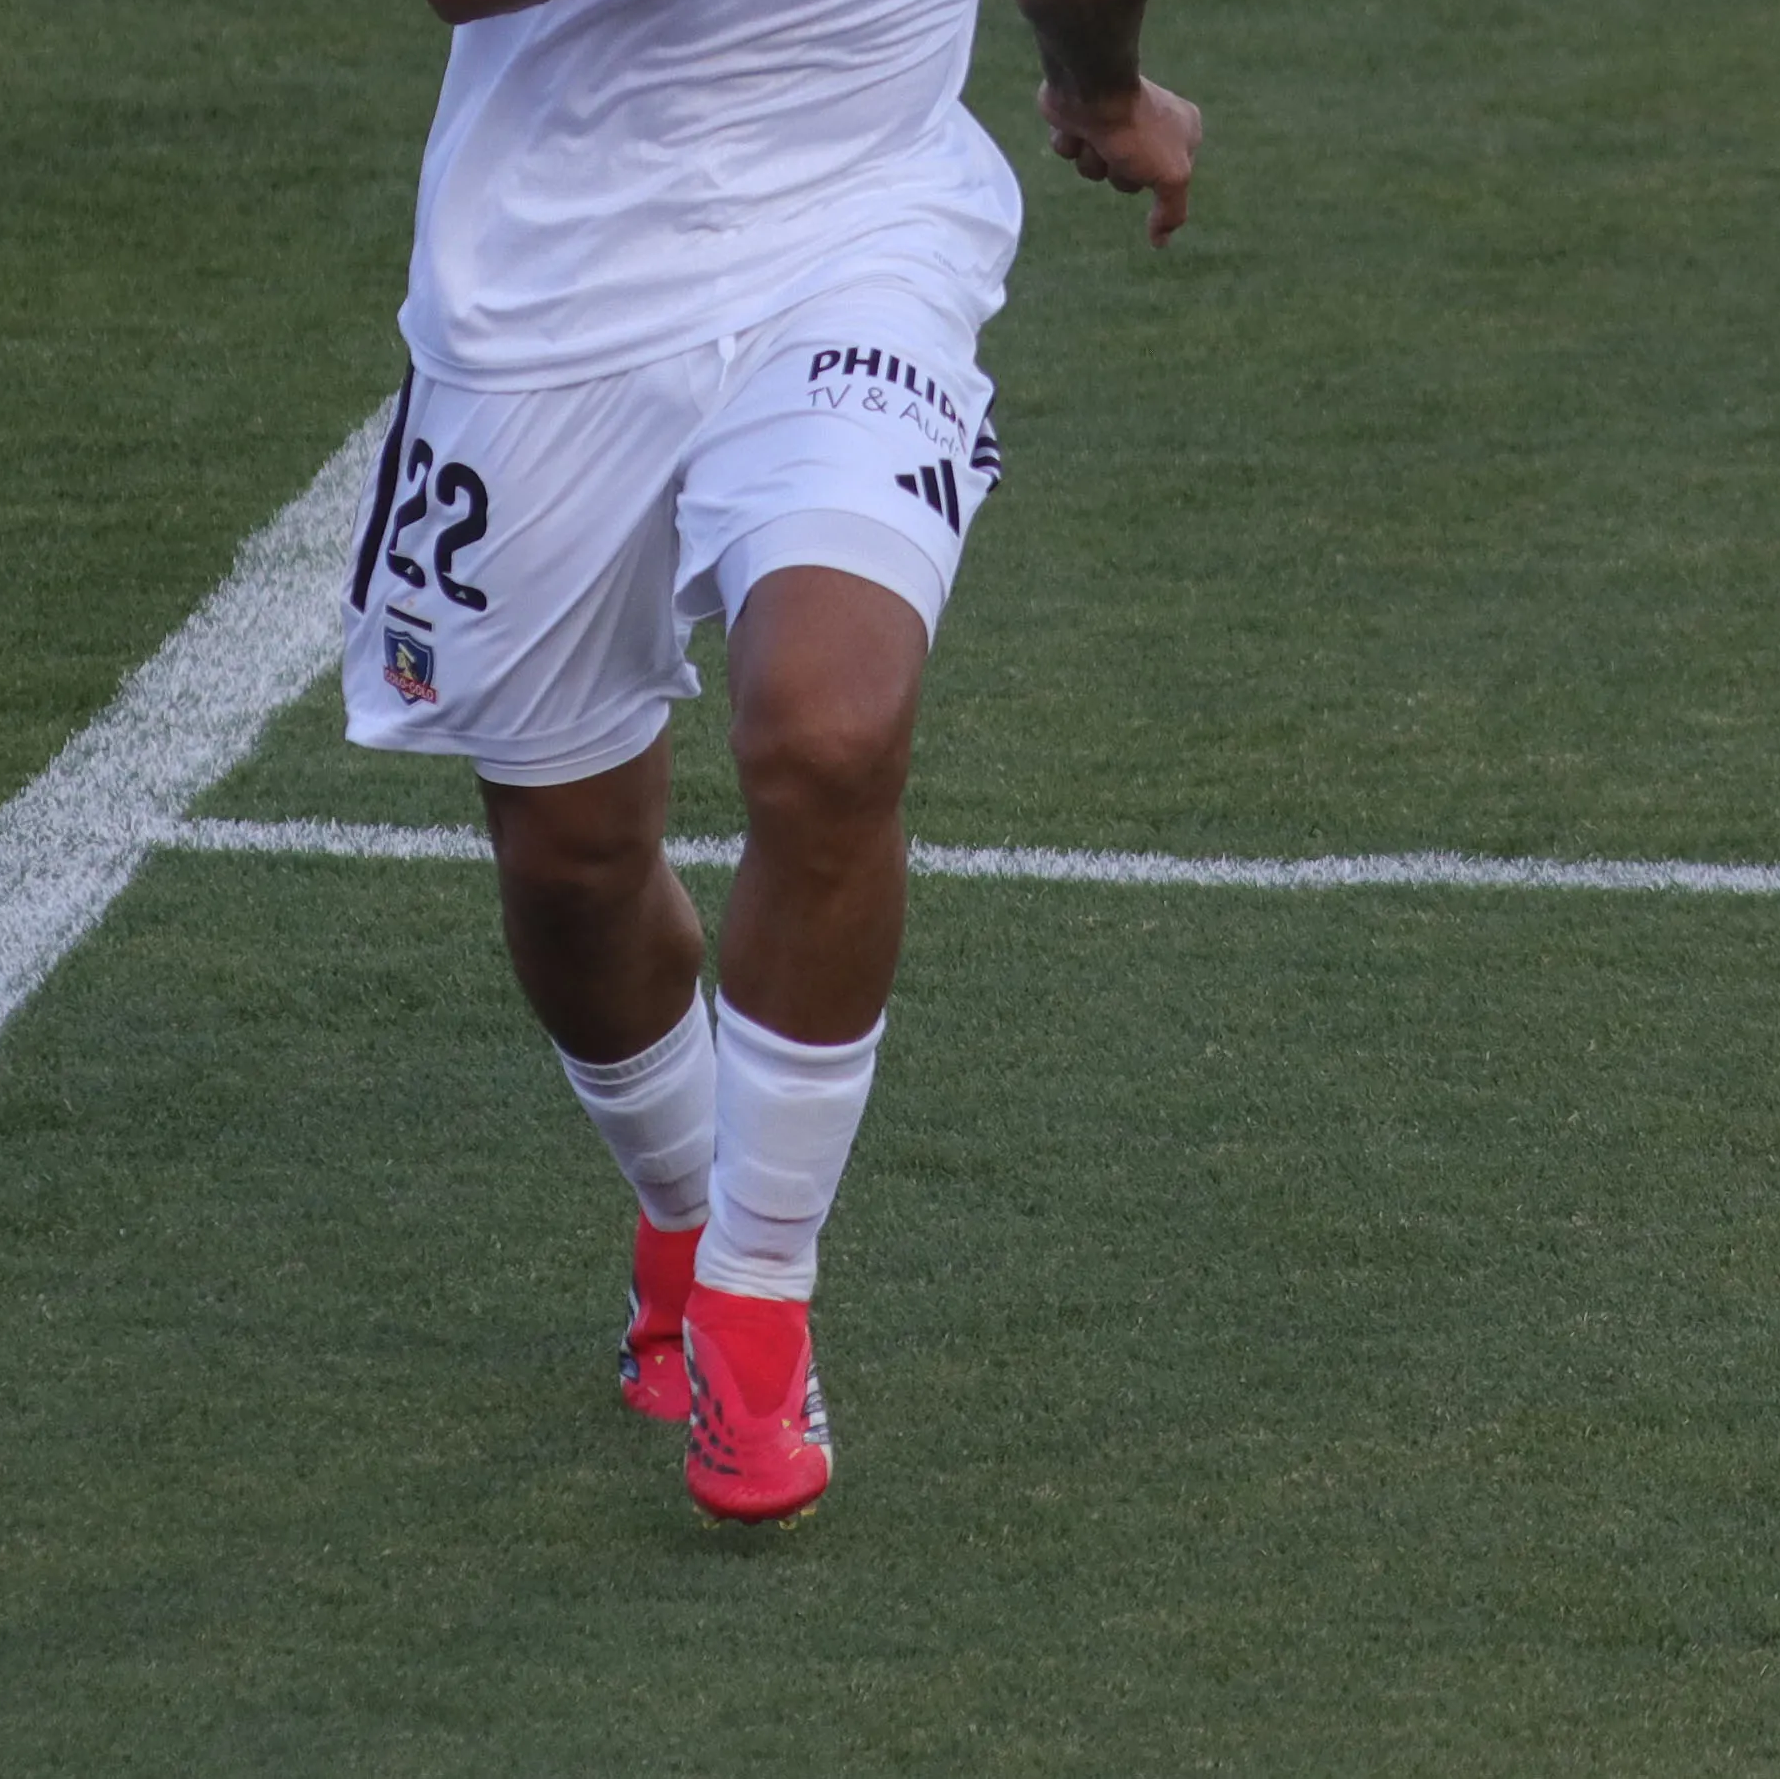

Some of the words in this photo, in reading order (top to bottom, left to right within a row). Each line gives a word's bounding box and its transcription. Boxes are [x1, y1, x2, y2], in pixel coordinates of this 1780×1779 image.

[806, 384, 852, 410] TV
[861, 386, 889, 415] &
[385, 437, 489, 613] 22
